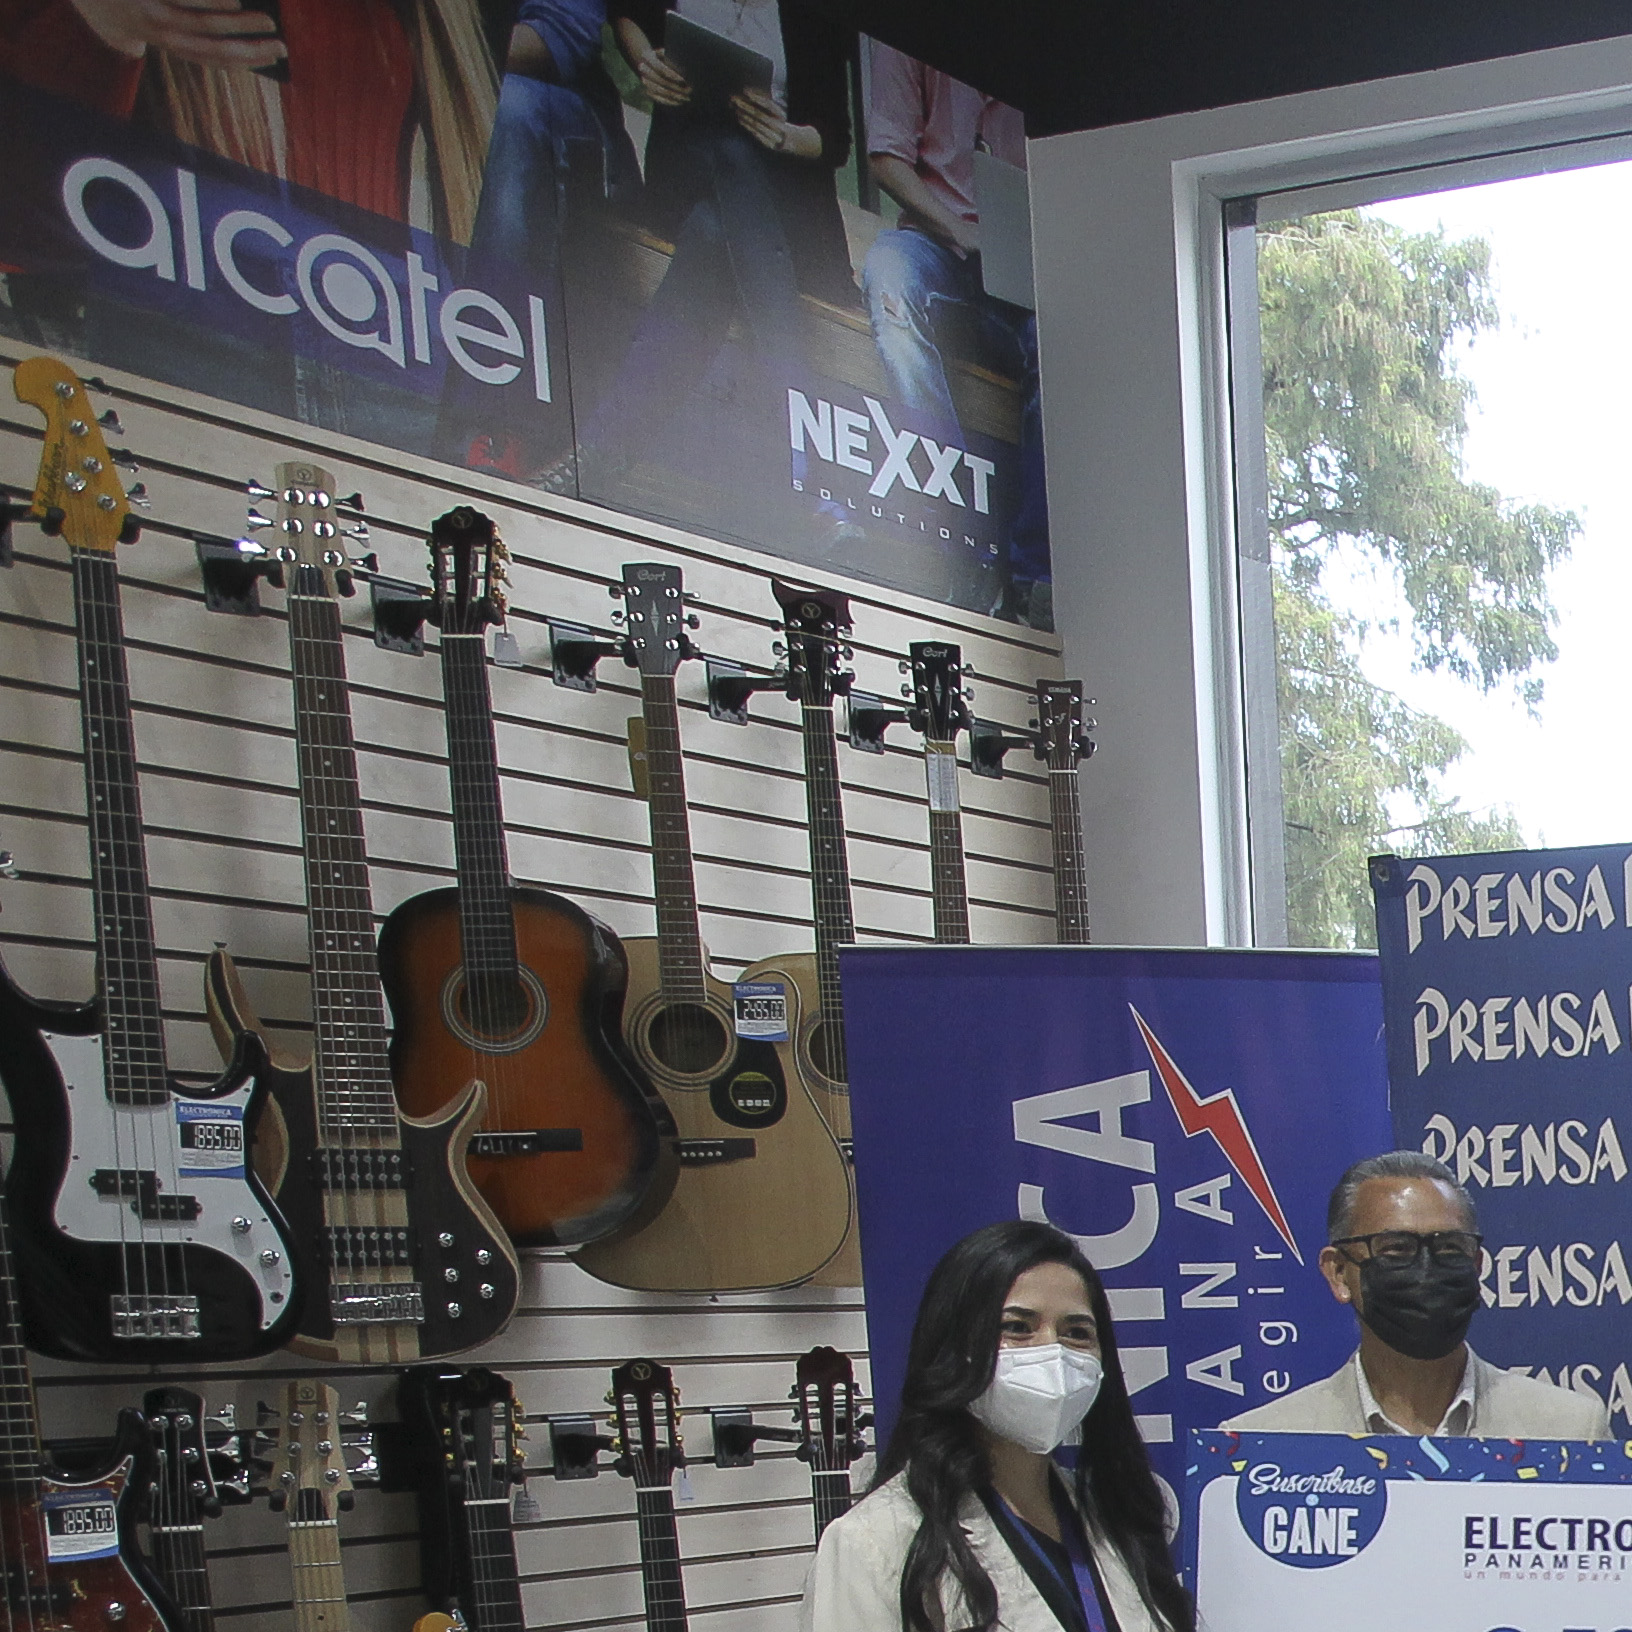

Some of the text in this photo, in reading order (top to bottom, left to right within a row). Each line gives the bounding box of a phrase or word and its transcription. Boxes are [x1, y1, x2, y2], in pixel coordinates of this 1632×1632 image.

[62, 157, 552, 402] alcatel
[787, 388, 995, 517] NEXXT
[790, 479, 999, 557] SOLUTIONS
[637, 569, 666, 581] Cort
[923, 646, 947, 657] Cort
[1407, 864, 1615, 953] PRENSA
[1414, 987, 1620, 1076] PRENSA
[1249, 1246, 1298, 1390] egir
[64, 1507, 113, 1533] 1895.00
[1463, 1571, 1485, 1580] un
[1499, 1571, 1565, 1581] mundo
[1577, 1572, 1621, 1583] para
